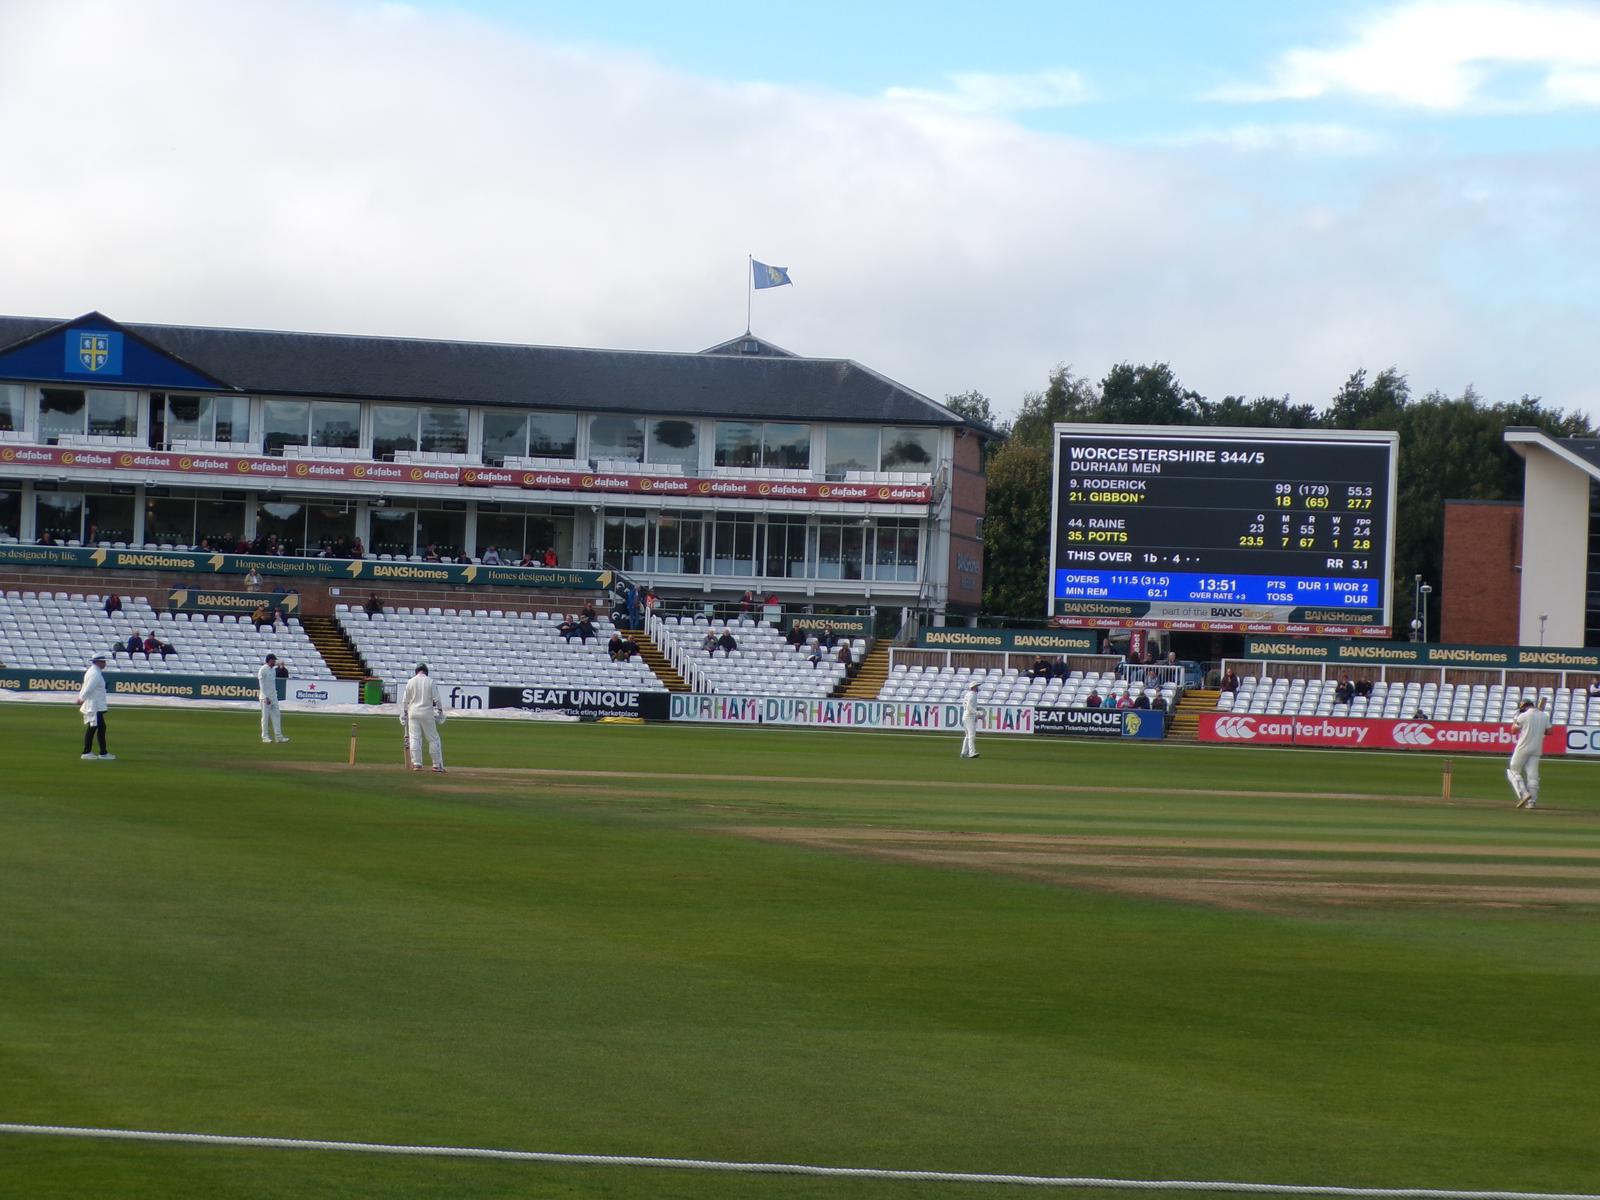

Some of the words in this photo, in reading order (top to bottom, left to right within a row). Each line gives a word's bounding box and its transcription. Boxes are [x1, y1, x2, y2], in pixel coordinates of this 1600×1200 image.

[16, 450, 52, 460] dafabet
[75, 453, 112, 464] dafabet
[134, 455, 170, 466] dafabet
[1071, 447, 1215, 462] WORCESTERSHIRE
[1220, 451, 1264, 464] 344/5
[193, 458, 228, 469] dafabet
[251, 461, 287, 472] dafabet
[1070, 461, 1128, 472] DURHAM
[1132, 463, 1161, 473] MEN
[309, 464, 344, 475] dafabet
[367, 466, 401, 477] dafabet
[423, 469, 459, 480] dafabet
[477, 471, 512, 482] dafabet
[536, 474, 570, 485] dafabet
[594, 477, 629, 487] dafabet
[653, 479, 688, 490] dafabet
[711, 482, 747, 492] dafabet
[771, 484, 807, 495] dafabet
[1070, 479, 1080, 488] 9.
[1083, 479, 1146, 490] RODERICK
[1275, 484, 1291, 494] 99
[1299, 484, 1329, 496] (179)
[1348, 487, 1372, 496] 55.3
[831, 486, 867, 497] dafabet
[891, 488, 925, 499] dafabet
[1069, 491, 1086, 501] 21.
[1276, 496, 1291, 506] 18
[1305, 496, 1329, 508] (65)
[1347, 499, 1372, 508] 27.7
[1309, 515, 1316, 523] R
[1333, 516, 1341, 524] W
[1356, 518, 1371, 526] rpo
[1068, 518, 1085, 528] 44.
[1089, 518, 1125, 528] RAINE
[1250, 524, 1264, 533] 23
[1282, 524, 1289, 534] 5
[1300, 525, 1314, 534] 55
[1333, 526, 1340, 535] 2
[1354, 527, 1370, 536] 2.4
[1068, 531, 1085, 541] 35.
[1088, 532, 1128, 542] POTTS
[1239, 536, 1264, 546] 23.5
[1282, 537, 1288, 546] 7
[1300, 538, 1314, 547] 67
[1333, 539, 1338, 548] 1
[1353, 539, 1370, 549] 2.8
[8, 549, 47, 561] designed
[49, 551, 58, 562] by
[62, 551, 77, 561] life.
[117, 554, 195, 568] BANKSHomes
[1067, 551, 1095, 561] THIS
[1099, 551, 1132, 562] OVER
[1144, 554, 1157, 563] 1b
[1172, 555, 1180, 563] 4
[235, 560, 265, 569] Homes
[267, 561, 304, 572] designed
[306, 562, 316, 573] by
[318, 562, 334, 572] life.
[1327, 559, 1343, 569] RR
[1352, 559, 1368, 569] 3.1
[374, 565, 449, 579] BANKSHomes
[488, 571, 517, 580] Homes
[518, 571, 555, 583] designed
[557, 574, 568, 584] by
[569, 574, 584, 583] life.
[1066, 575, 1099, 583] OVERS
[1112, 575, 1138, 584] 111.5
[1141, 576, 1169, 586] (31.5)
[1198, 579, 1236, 591] 13:51
[1066, 587, 1084, 595] MIN
[1087, 588, 1108, 596] REM
[1148, 588, 1168, 597] 62.1
[1267, 581, 1286, 589] PTS
[1297, 581, 1321, 590] DUR
[1334, 582, 1359, 591] WOR
[1362, 583, 1369, 592] 2
[197, 595, 270, 608] BANKSHomes
[1267, 593, 1293, 601] TOSS
[1344, 595, 1368, 604] DUR
[1064, 603, 1132, 614] BANKSHomes
[1162, 608, 1180, 617] part
[1183, 607, 1192, 616] of
[1305, 611, 1373, 622] BANKSHomes
[792, 619, 864, 630] BANKSHomes
[1134, 620, 1157, 628] dafabet
[1172, 621, 1195, 629] dafabet
[1210, 622, 1233, 630] dafabet
[1324, 626, 1348, 634] dafabet
[926, 632, 1002, 645] BANKSHomes
[1014, 635, 1090, 648] BANKSHomes
[1250, 643, 1328, 656] BANKSHomes
[1339, 646, 1417, 659] BANKSHomes
[1429, 649, 1507, 662] BANKSHomes
[1519, 652, 1598, 665] BANKSHomes
[29, 679, 82, 690] BANKSHo
[115, 681, 193, 695] BANKSHomes
[522, 689, 567, 704] SEAT
[570, 690, 639, 708] UNIQUE
[599, 709, 639, 717] Marketplace
[672, 696, 756, 720] DURHAM
[766, 698, 851, 724] DURHAM
[854, 702, 939, 727] DURHAM
[1067, 712, 1122, 725] UNIQUE
[1065, 725, 1088, 733] Ticketing
[1259, 720, 1368, 742] canterbury
[1437, 726, 1520, 744] canterbu
